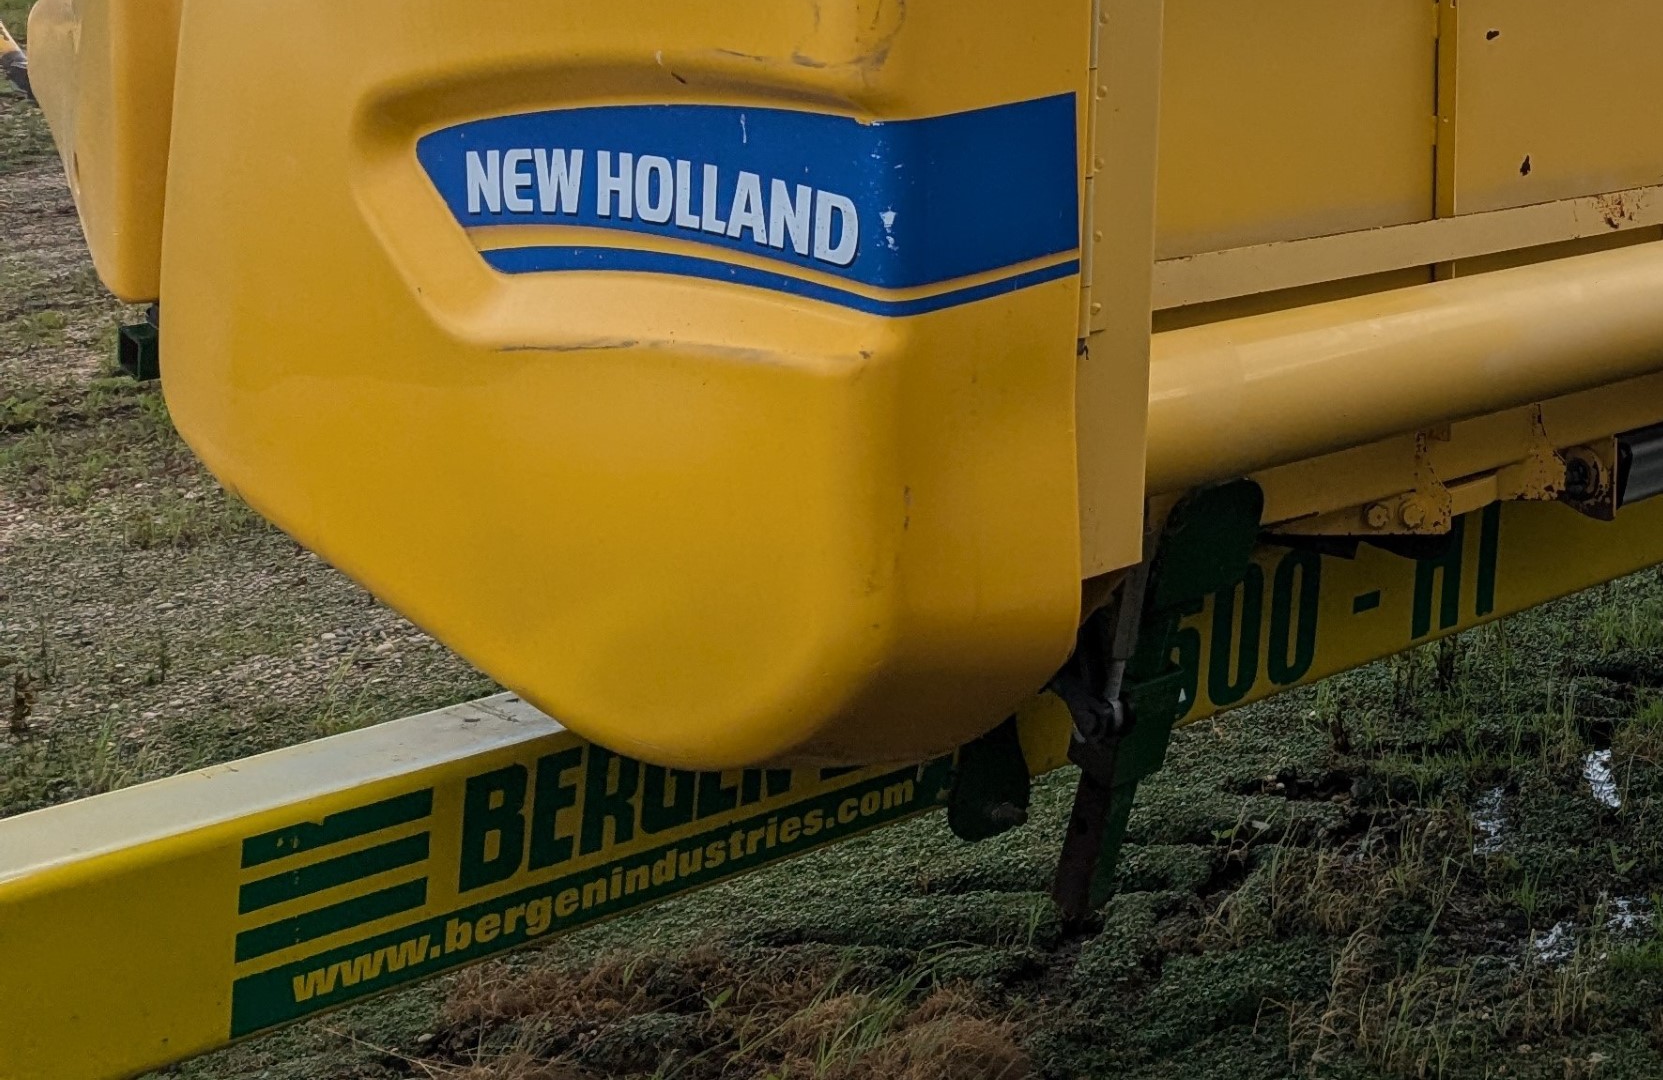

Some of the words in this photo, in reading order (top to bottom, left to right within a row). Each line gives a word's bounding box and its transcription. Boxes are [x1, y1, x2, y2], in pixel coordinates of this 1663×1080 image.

[465, 147, 583, 215] NEW
[596, 150, 859, 267] HOLLAND
[292, 777, 915, 1003] www.bergenindustries.com
